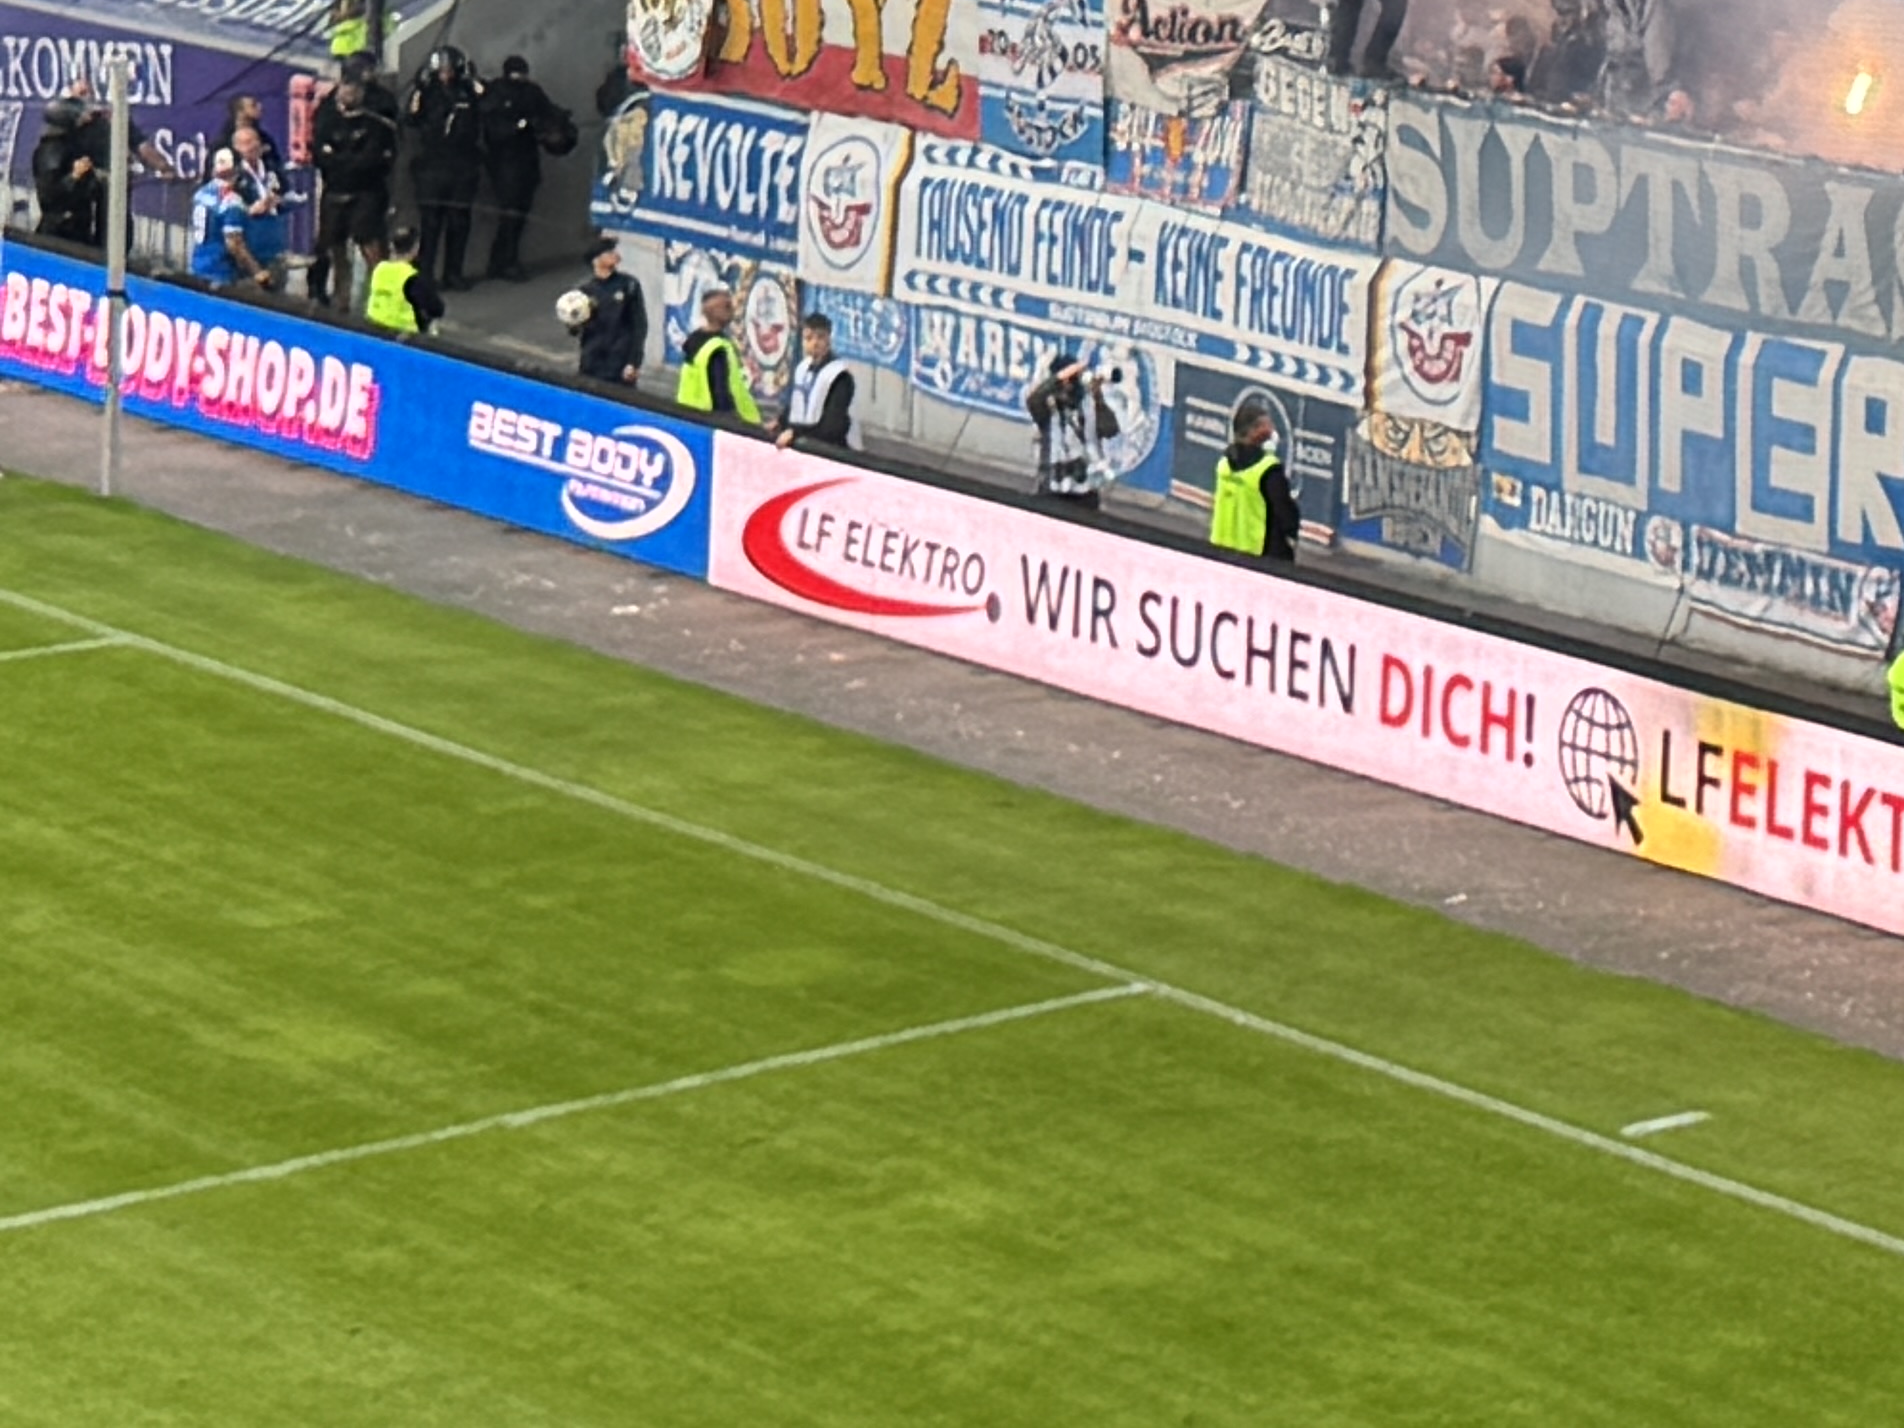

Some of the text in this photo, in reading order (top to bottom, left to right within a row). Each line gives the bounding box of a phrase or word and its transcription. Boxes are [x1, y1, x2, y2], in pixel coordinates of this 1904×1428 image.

[0, 34, 173, 105] KOMMEN
[154, 128, 208, 180] Sch
[652, 108, 808, 224] REVOLTE
[915, 176, 1030, 276] TAUSEND
[1032, 198, 1124, 296] FEINDE
[1154, 220, 1230, 321] KEINE
[1233, 240, 1358, 356] FREUNDE
[469, 400, 666, 488] BEST BODY
[799, 508, 837, 553] LF
[843, 512, 987, 596] ELEKTRO
[1020, 553, 1118, 649] WIR
[1135, 590, 1358, 715] SUCHEN
[1379, 653, 1538, 769] DICH!
